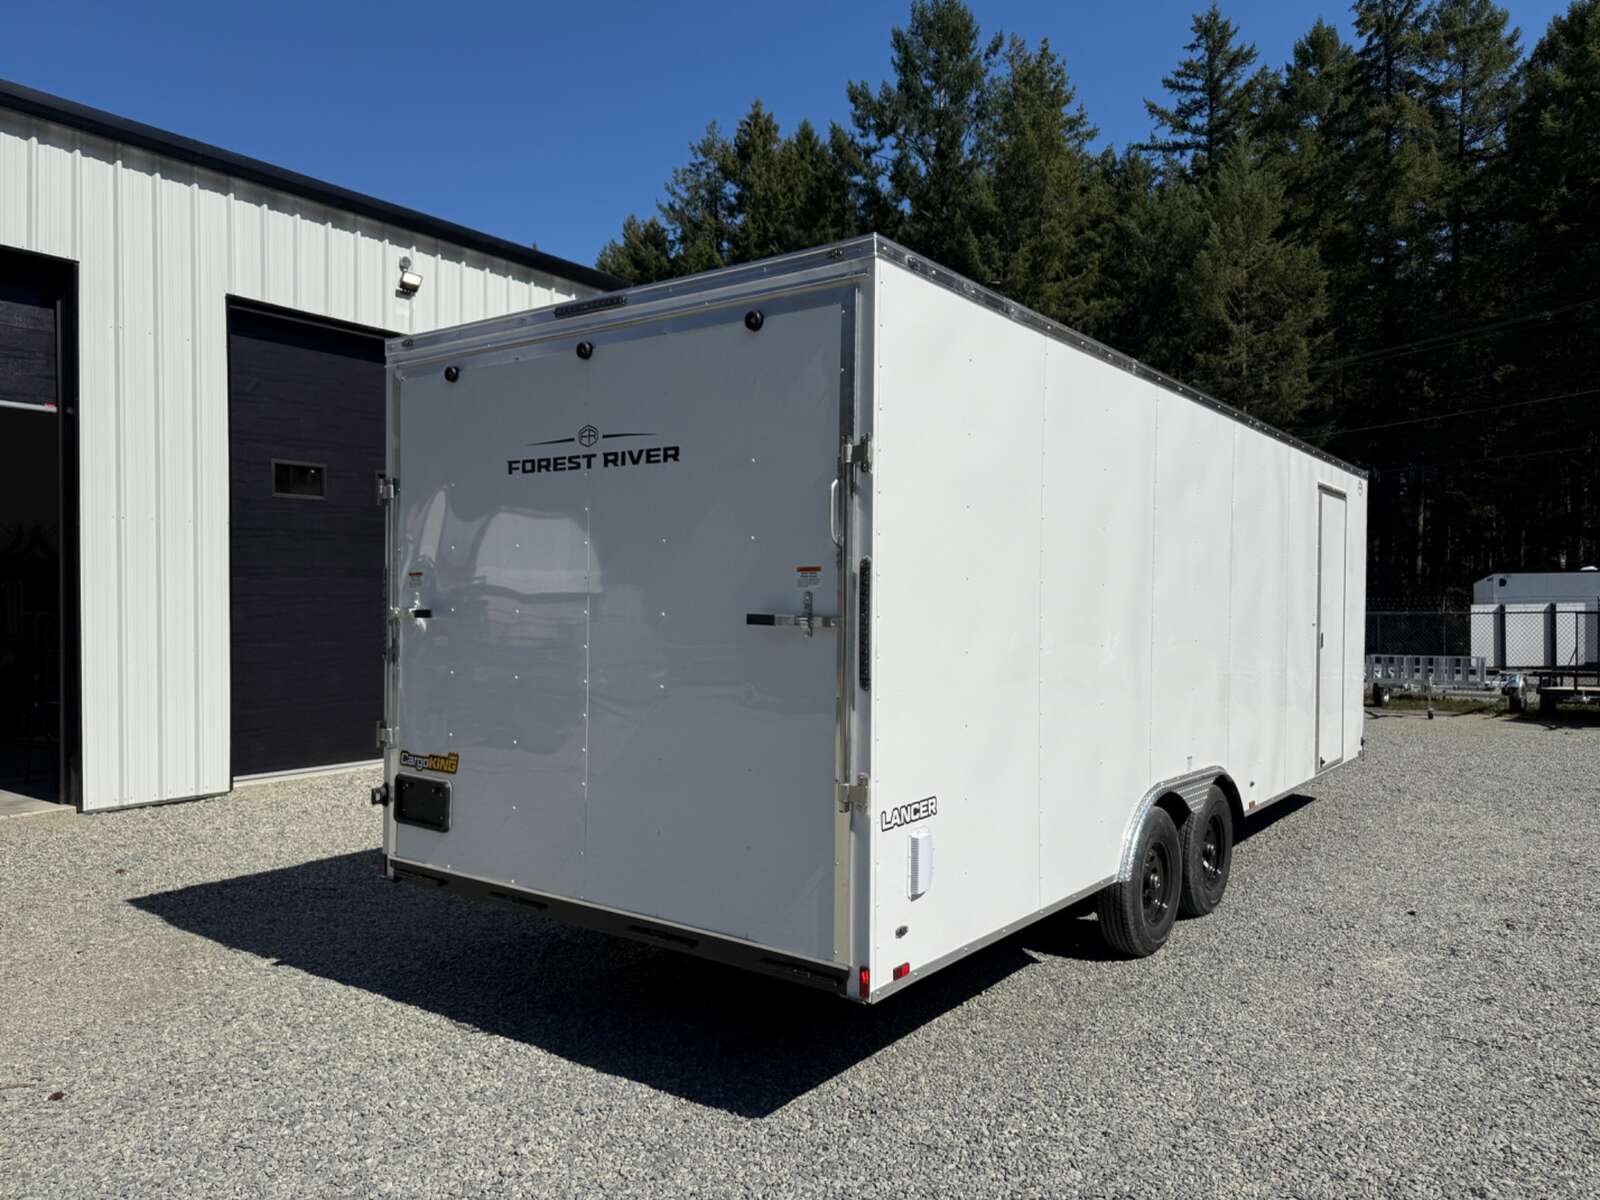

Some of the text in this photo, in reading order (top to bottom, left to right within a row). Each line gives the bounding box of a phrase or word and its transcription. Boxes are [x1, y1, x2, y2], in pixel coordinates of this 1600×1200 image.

[507, 446, 680, 475] FOREST RIVER
[401, 752, 457, 772] CargoKING
[881, 796, 937, 831] LANCER
